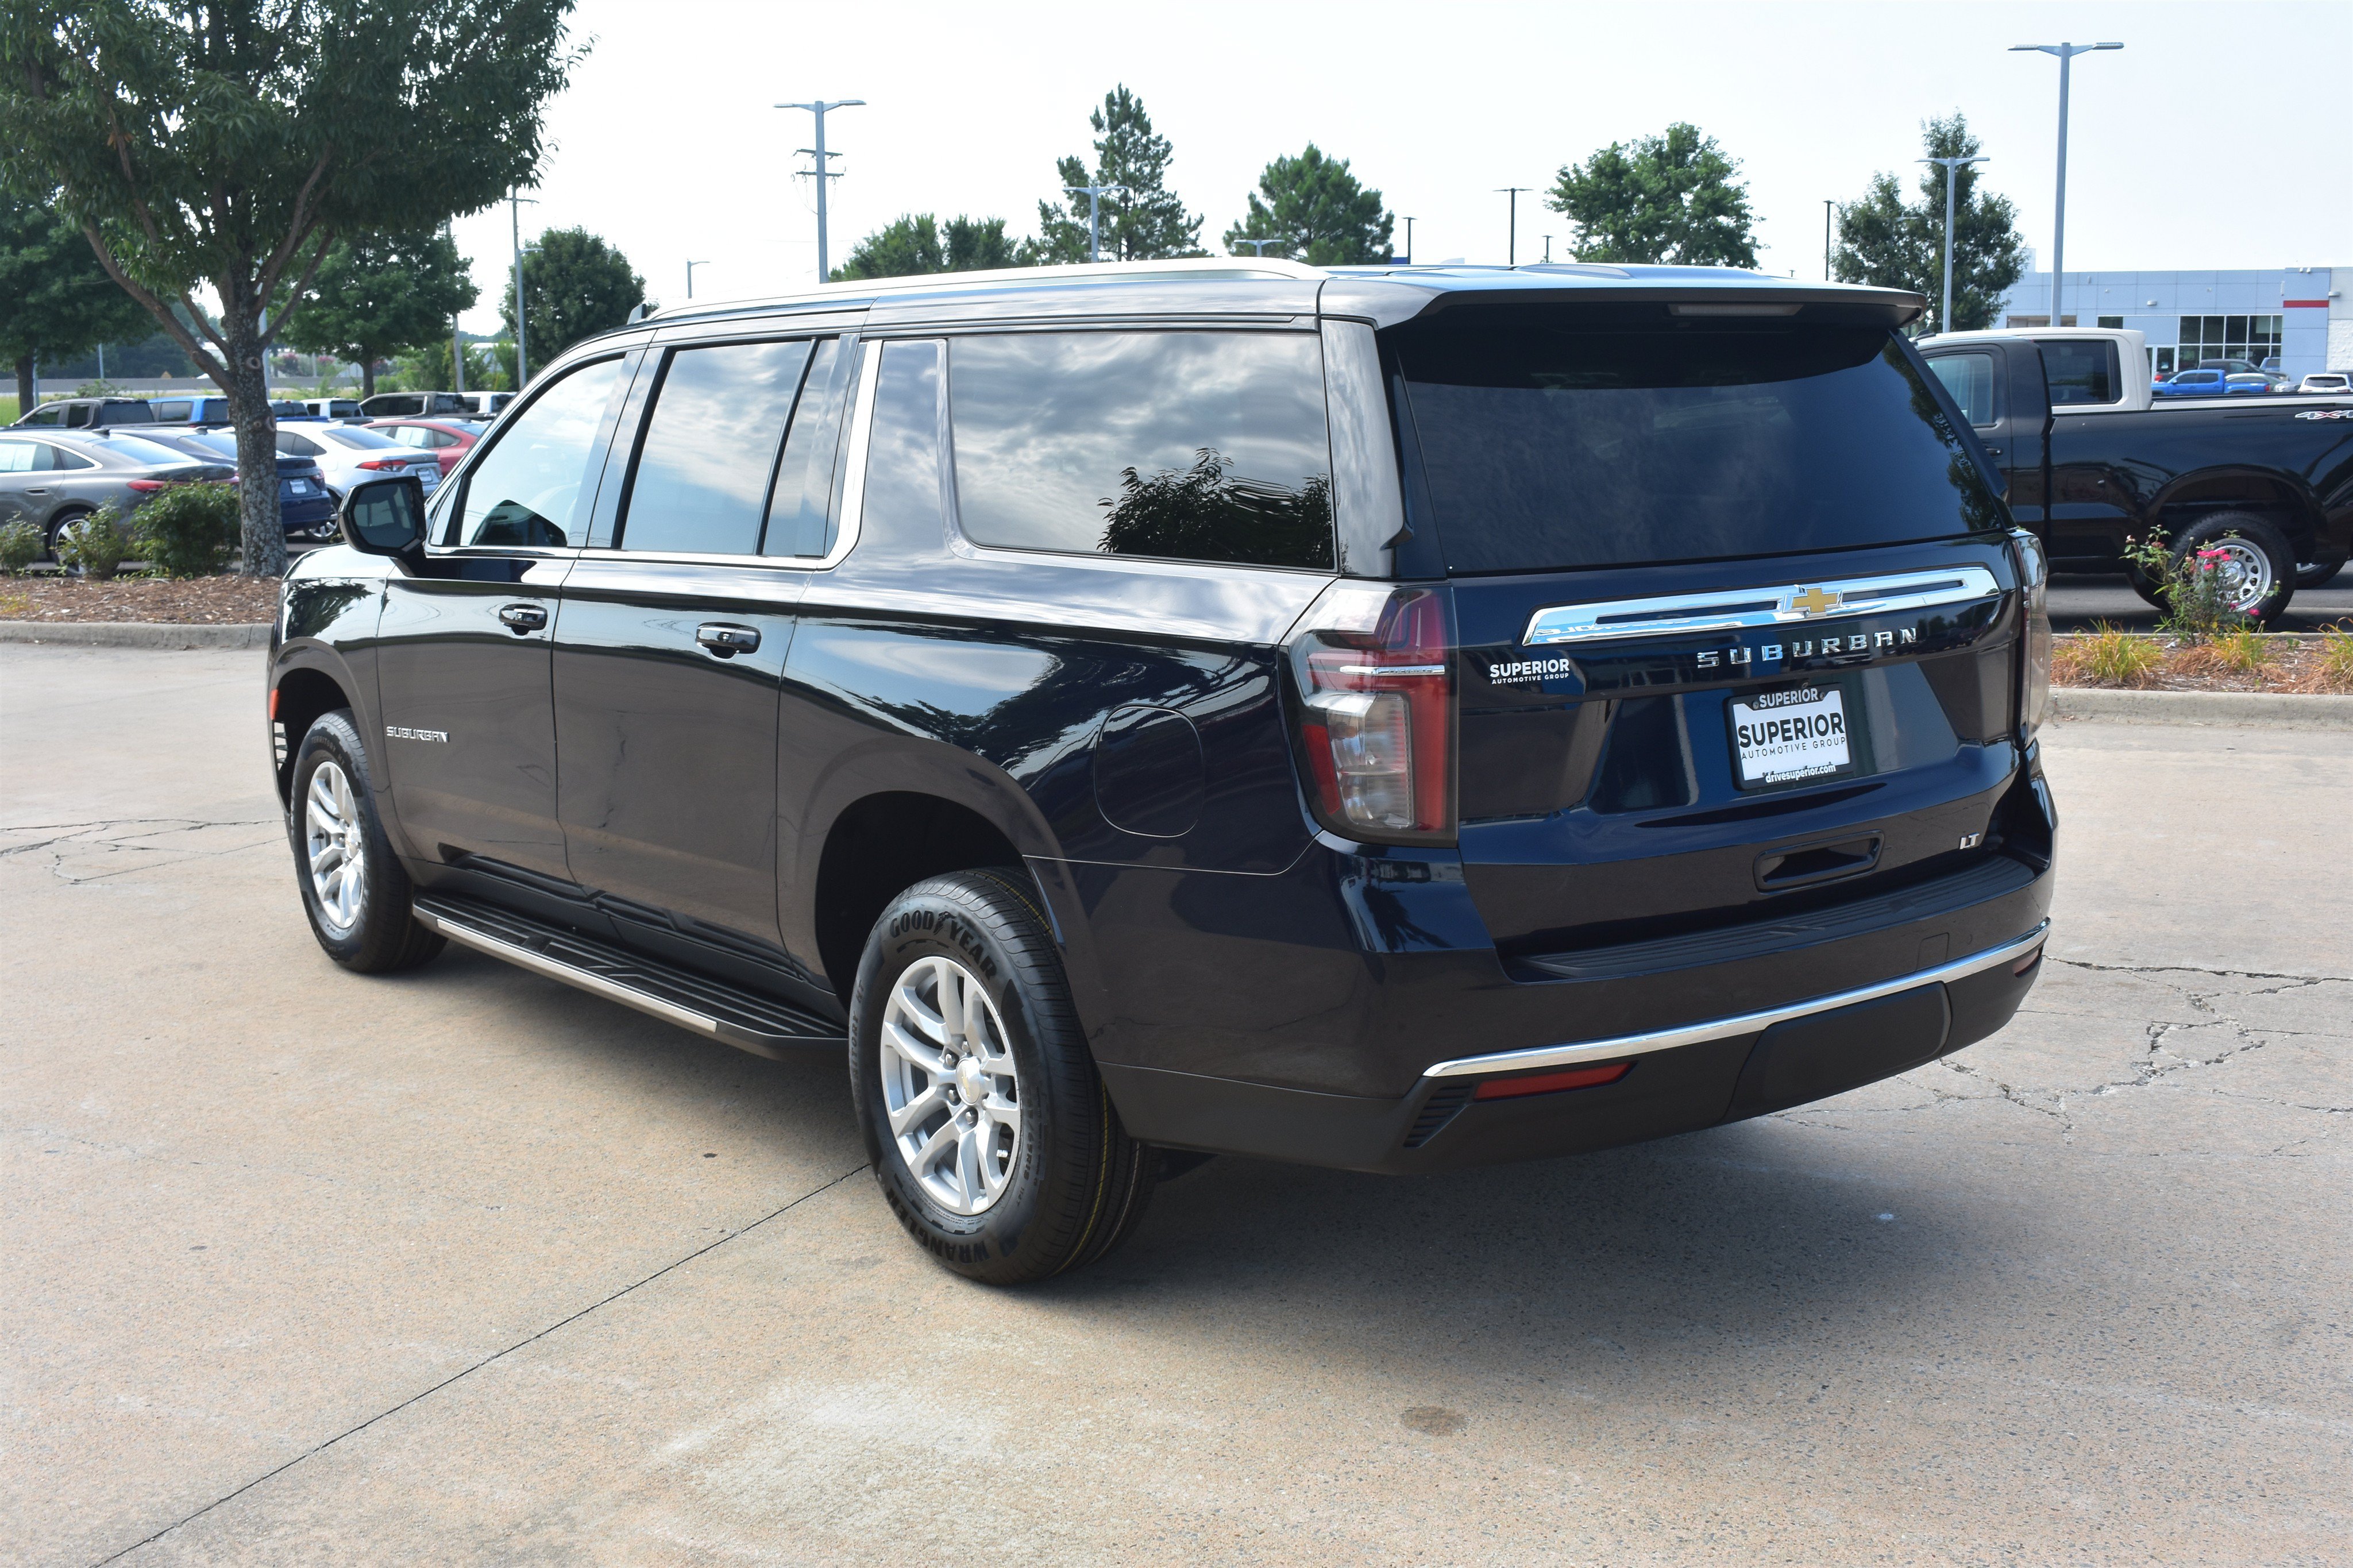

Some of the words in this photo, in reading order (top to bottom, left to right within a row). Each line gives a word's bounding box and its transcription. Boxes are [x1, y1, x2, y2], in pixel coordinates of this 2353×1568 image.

[1696, 627, 1918, 669] SUBURBAN
[1490, 658, 1570, 678] SUPERIOR
[1491, 675, 1542, 685] AUTOMOTIVE
[1758, 688, 1819, 708] SUPERIOR
[386, 725, 450, 743] SUBURBAN
[1738, 712, 1846, 748] SUPERIOR
[1741, 742, 1807, 760] AUTOMOTIVE
[1812, 737, 1846, 749] GROUP
[1765, 763, 1837, 783] drivesuperior.com
[1959, 832, 1981, 850] LT
[890, 910, 998, 981] GOODYEAR
[885, 1185, 992, 1265] WRANGLER
